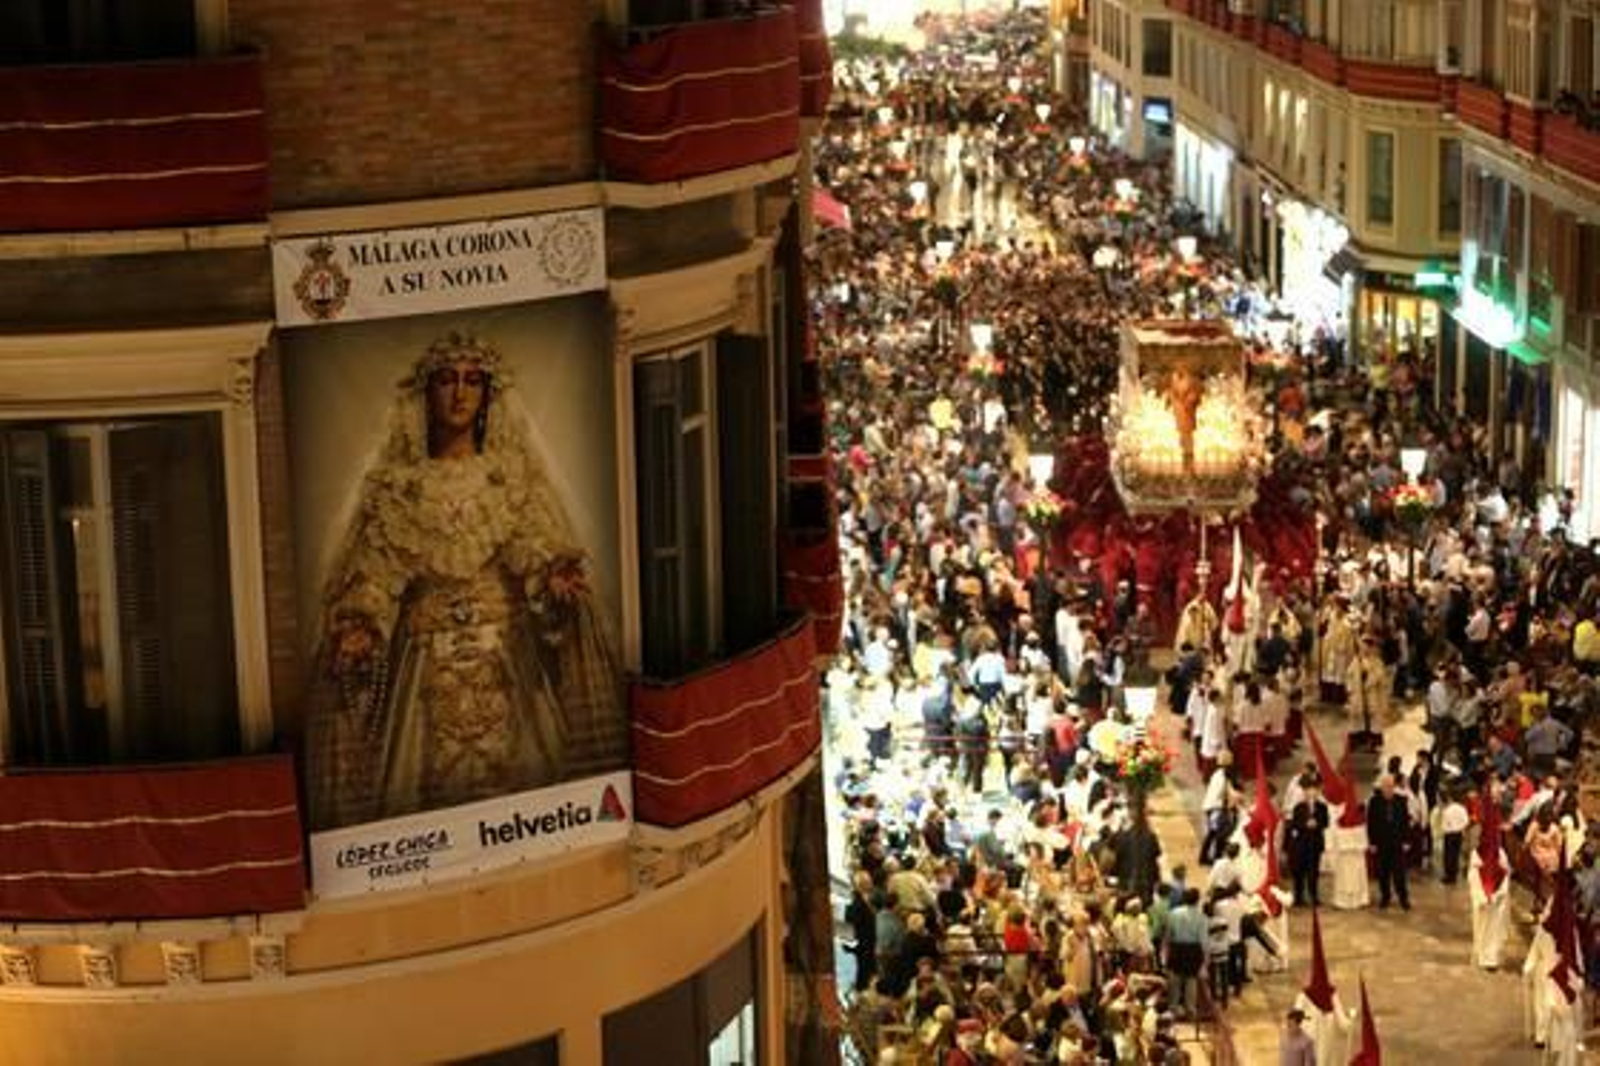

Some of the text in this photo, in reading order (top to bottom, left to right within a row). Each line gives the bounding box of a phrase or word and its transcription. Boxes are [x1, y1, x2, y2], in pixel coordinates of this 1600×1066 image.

[446, 229, 532, 257] CORONA
[379, 264, 508, 295] A SU NOVIA
[479, 802, 592, 847] helvetia
